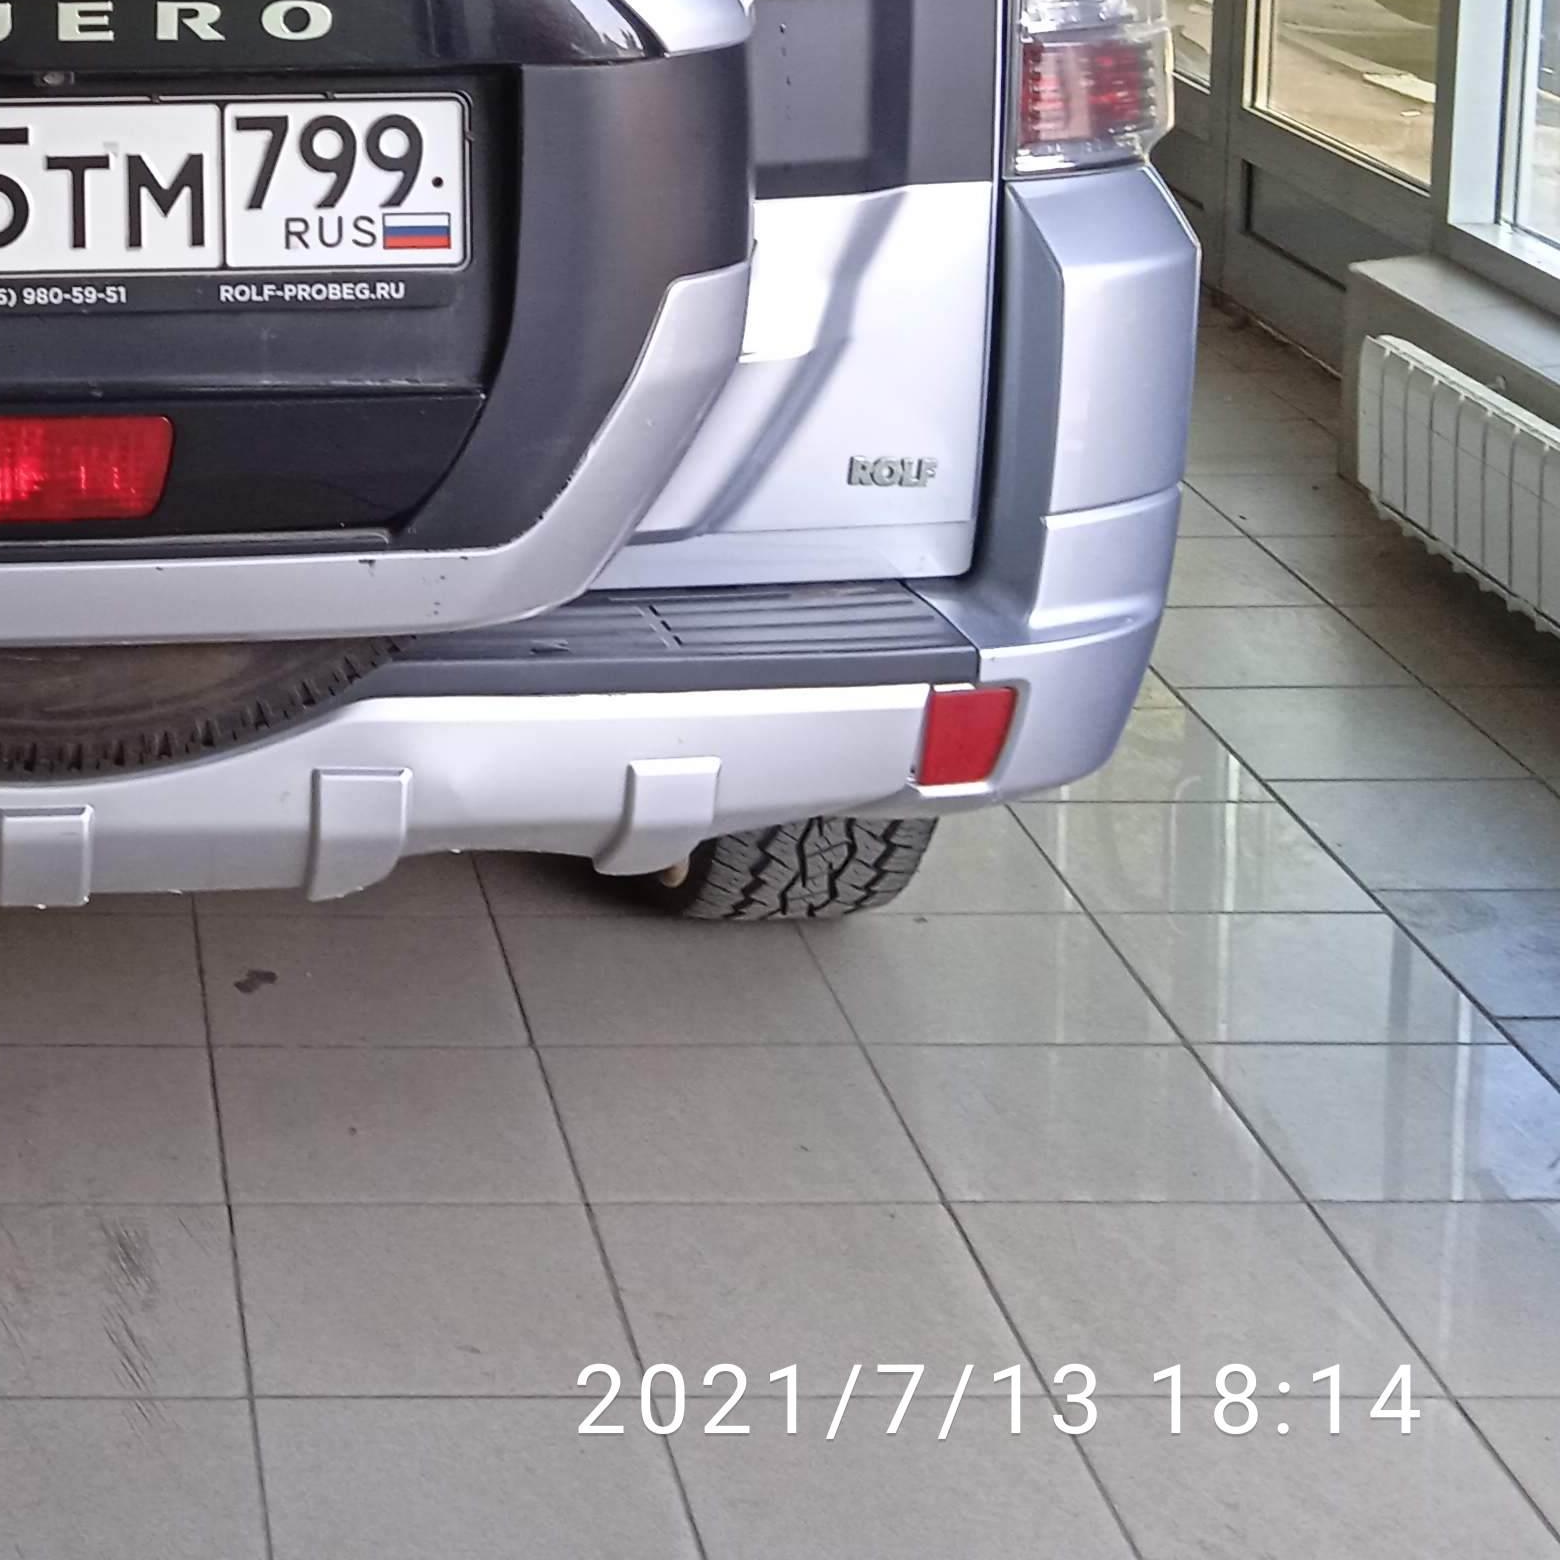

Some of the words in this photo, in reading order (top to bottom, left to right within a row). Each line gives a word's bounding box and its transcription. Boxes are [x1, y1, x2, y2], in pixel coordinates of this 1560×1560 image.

[235, 113, 423, 210] 799
[284, 215, 377, 250] RUS
[22, 286, 127, 305] 980-59-51
[220, 282, 405, 303] ROLF-PROBEG.RU
[847, 455, 938, 487] ROLF
